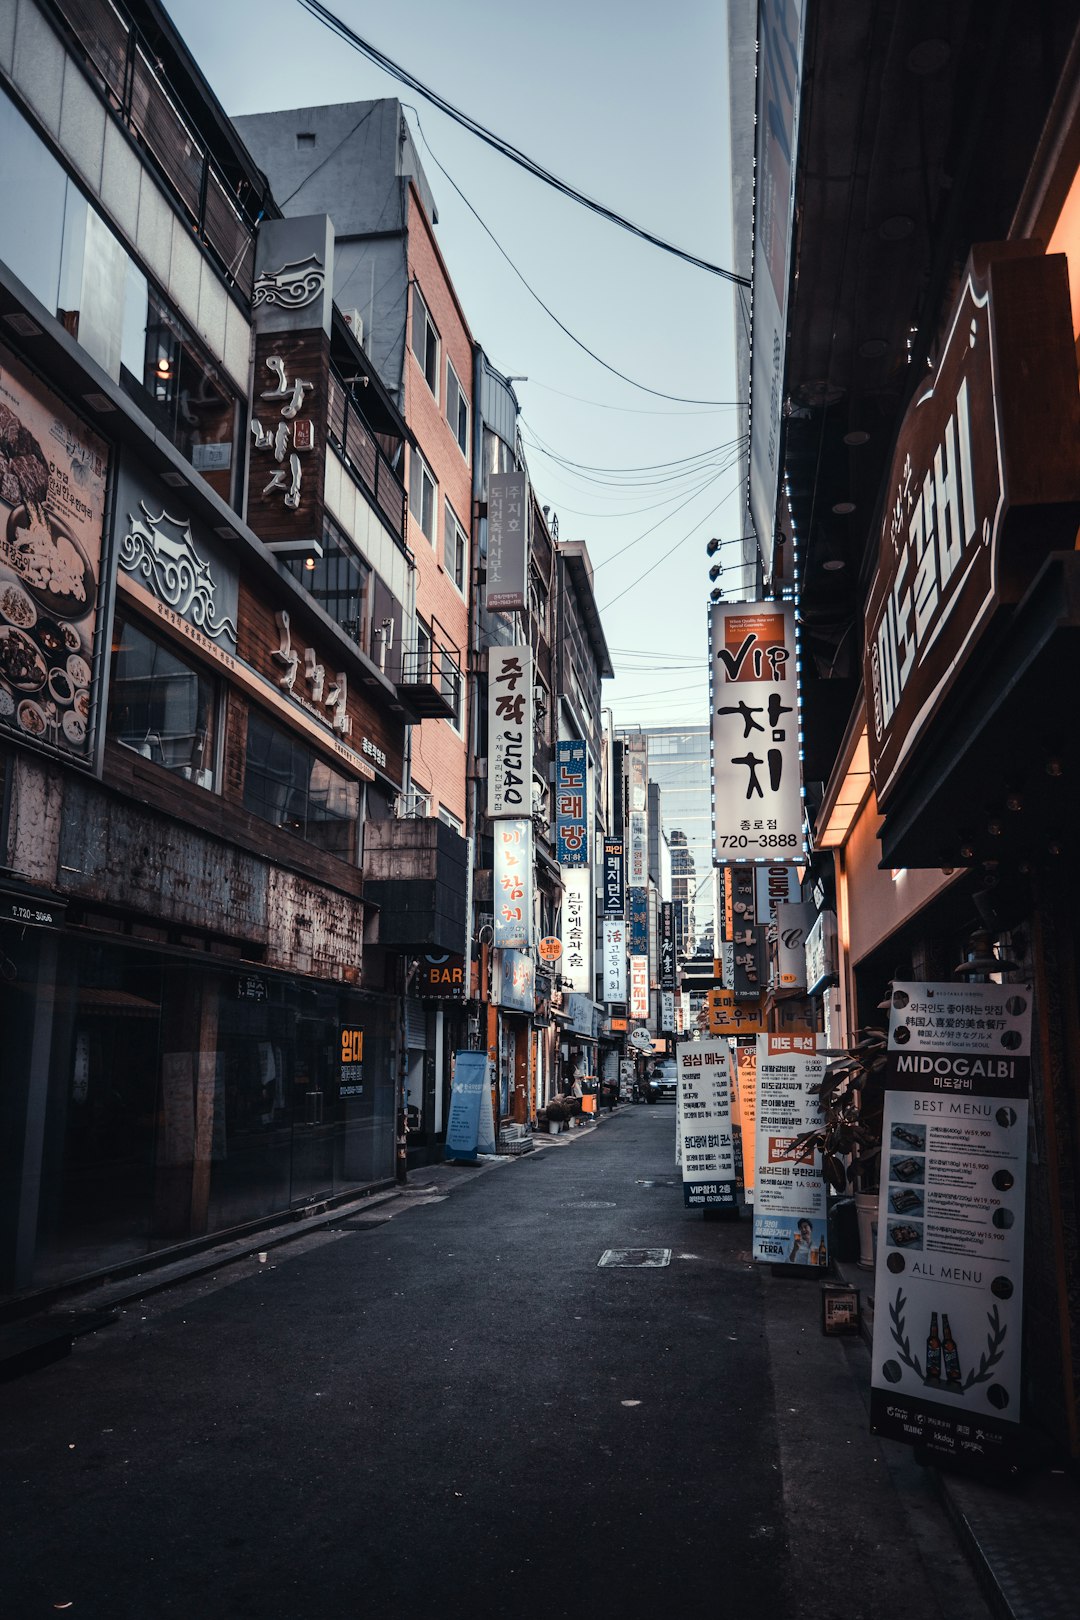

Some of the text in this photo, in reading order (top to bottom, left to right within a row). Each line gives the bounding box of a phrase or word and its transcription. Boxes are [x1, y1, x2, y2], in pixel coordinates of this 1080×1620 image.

[878, 376, 976, 730] 미도갈비
[717, 633, 790, 681] VIP
[496, 657, 526, 725] 주작
[717, 693, 793, 799] 참치
[560, 766, 586, 851] 노래방
[740, 819, 777, 830] 종로점
[720, 834, 797, 847] 720-3888
[605, 845, 622, 854] 파인
[500, 830, 523, 921] 미노참치
[607, 857, 620, 908] 레지던스
[738, 886, 752, 894] 구이
[607, 930, 622, 943] 活
[541, 944, 559, 954] 노래방
[608, 945, 620, 991] 고등어회
[430, 968, 463, 984] BAR
[633, 962, 646, 1010] 부대찌개
[910, 1003, 1003, 1015] 외국인도 좋아하는 맛집
[714, 1008, 762, 1027] 도우미
[905, 1016, 1007, 1030] 韩国人喜爱的美食餐厅
[918, 1030, 992, 1040] 韓国人が好きなグルメ
[771, 1037, 813, 1050] 미도 특선
[682, 1053, 725, 1067] 점심 메뉴
[897, 1056, 1014, 1078] MIDOGALBI
[933, 1077, 972, 1090] 미도갈비
[914, 1100, 991, 1116] BEST MENU
[708, 1134, 719, 1147] 참치
[721, 1134, 730, 1146] 코스
[759, 1166, 823, 1178] 샐러드바 무한리필
[689, 1184, 731, 1194] VIP참치 2층
[759, 1244, 783, 1255] TERRA
[912, 1262, 982, 1283] ALL MENU
